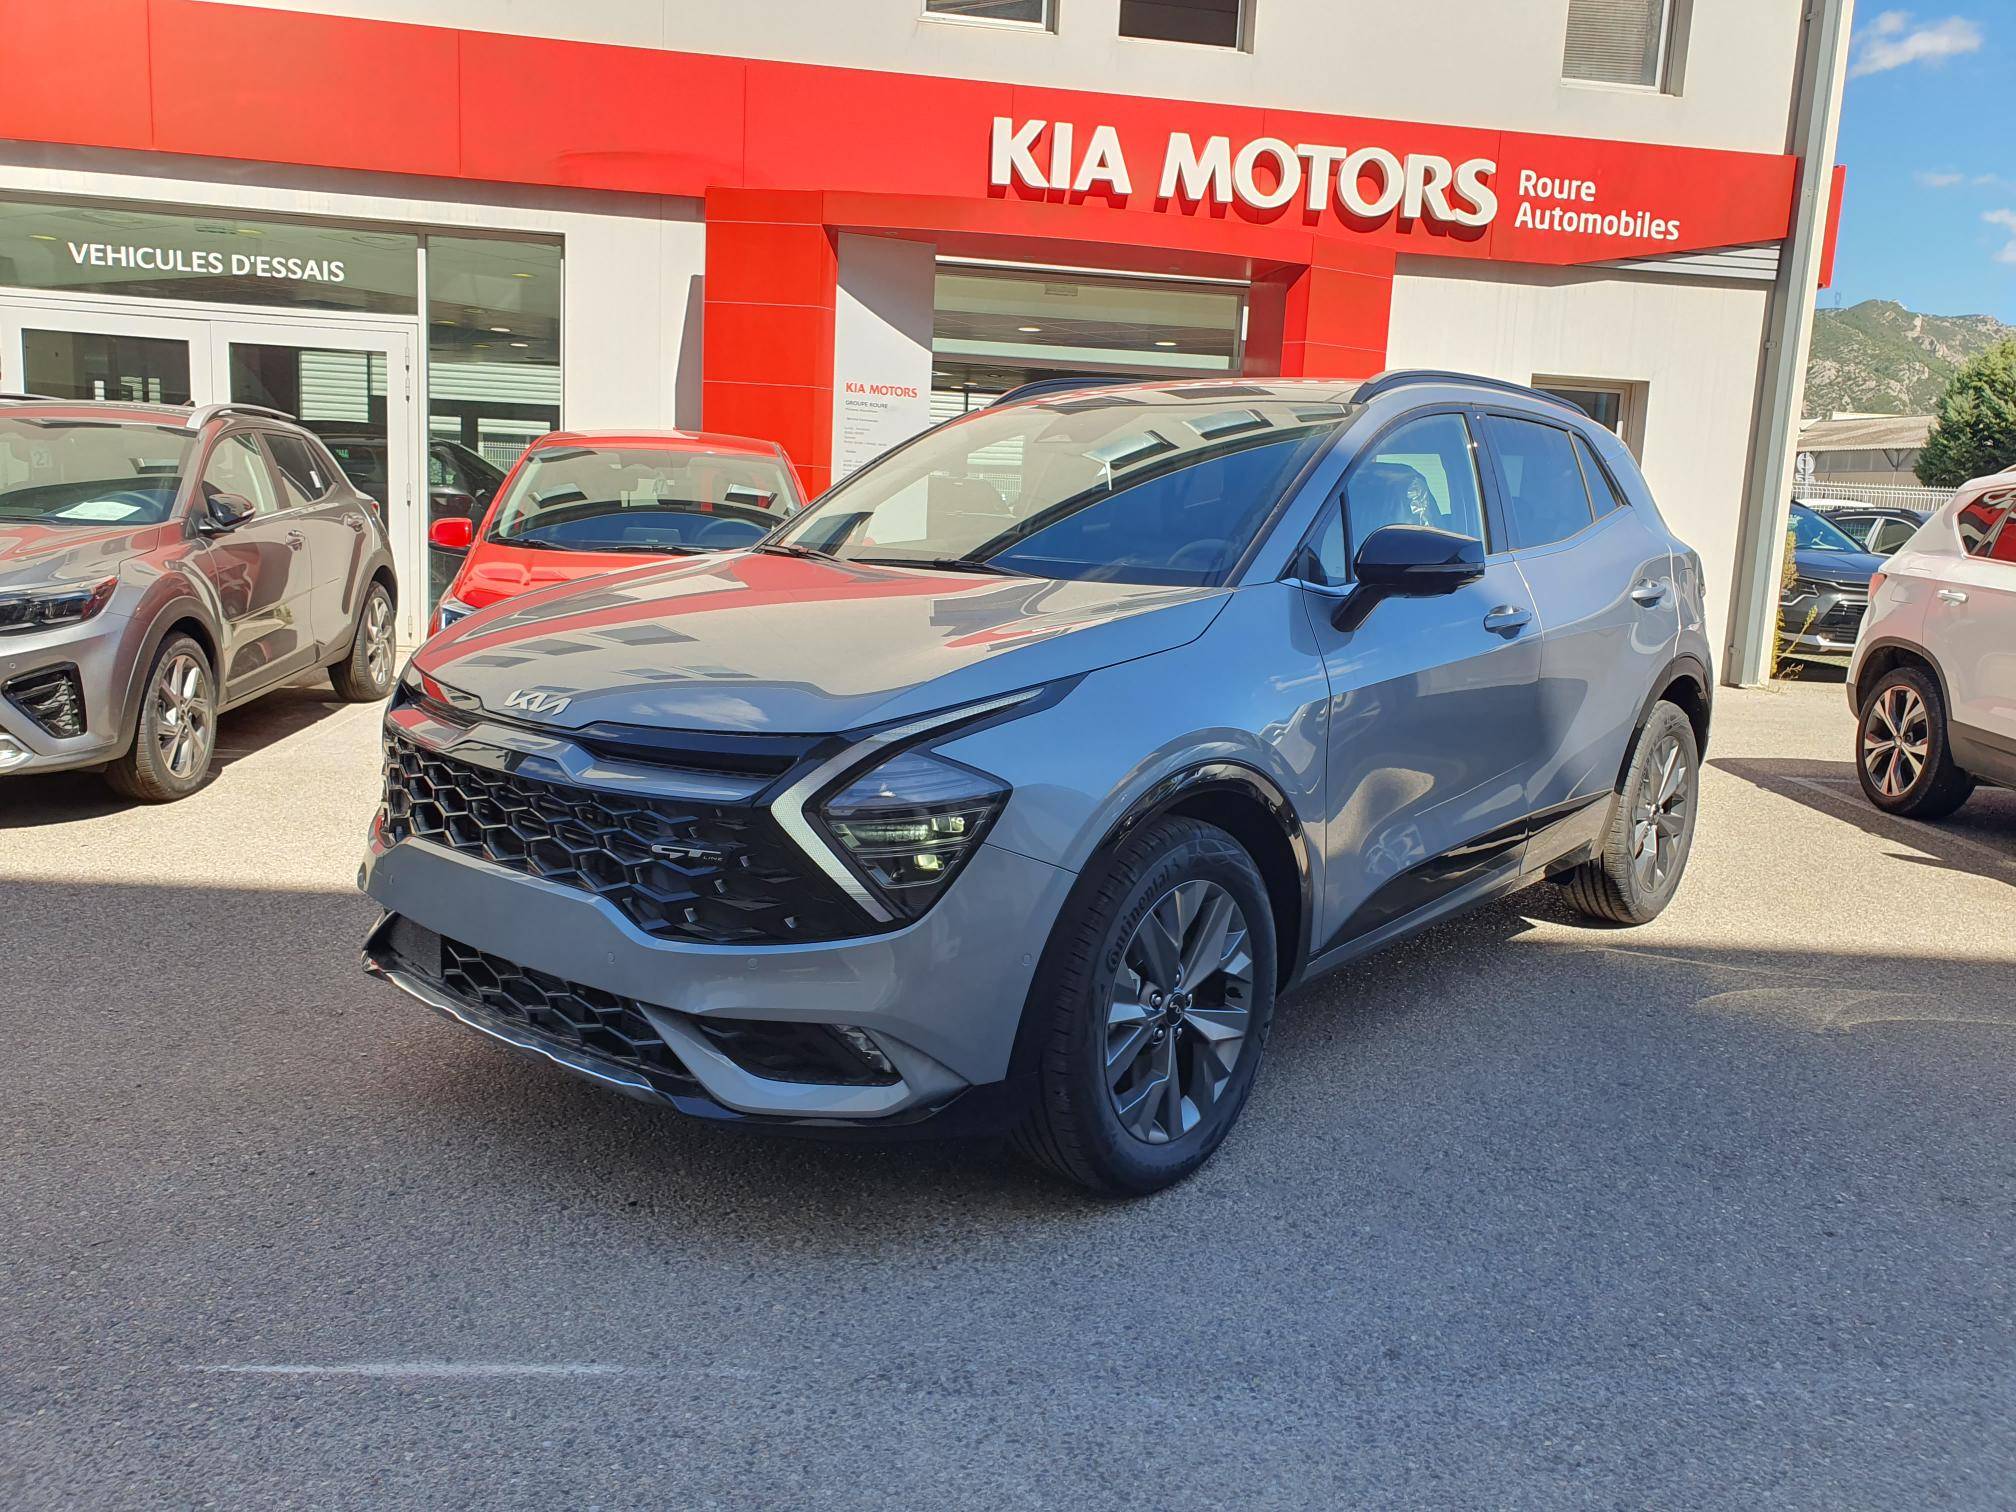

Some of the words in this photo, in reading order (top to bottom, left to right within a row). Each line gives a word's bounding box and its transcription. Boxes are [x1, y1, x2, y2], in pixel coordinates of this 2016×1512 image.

[990, 116, 1133, 197] KIA
[1156, 131, 1499, 227] MOTORS
[1518, 169, 1596, 202] Roure
[1514, 201, 1681, 241] Automobiles
[67, 241, 224, 274] VEHICULES
[231, 253, 345, 282] D'ESSAIS
[845, 382, 866, 393] KIA
[869, 384, 918, 398] MOTORS
[1106, 864, 1170, 974] Continental
